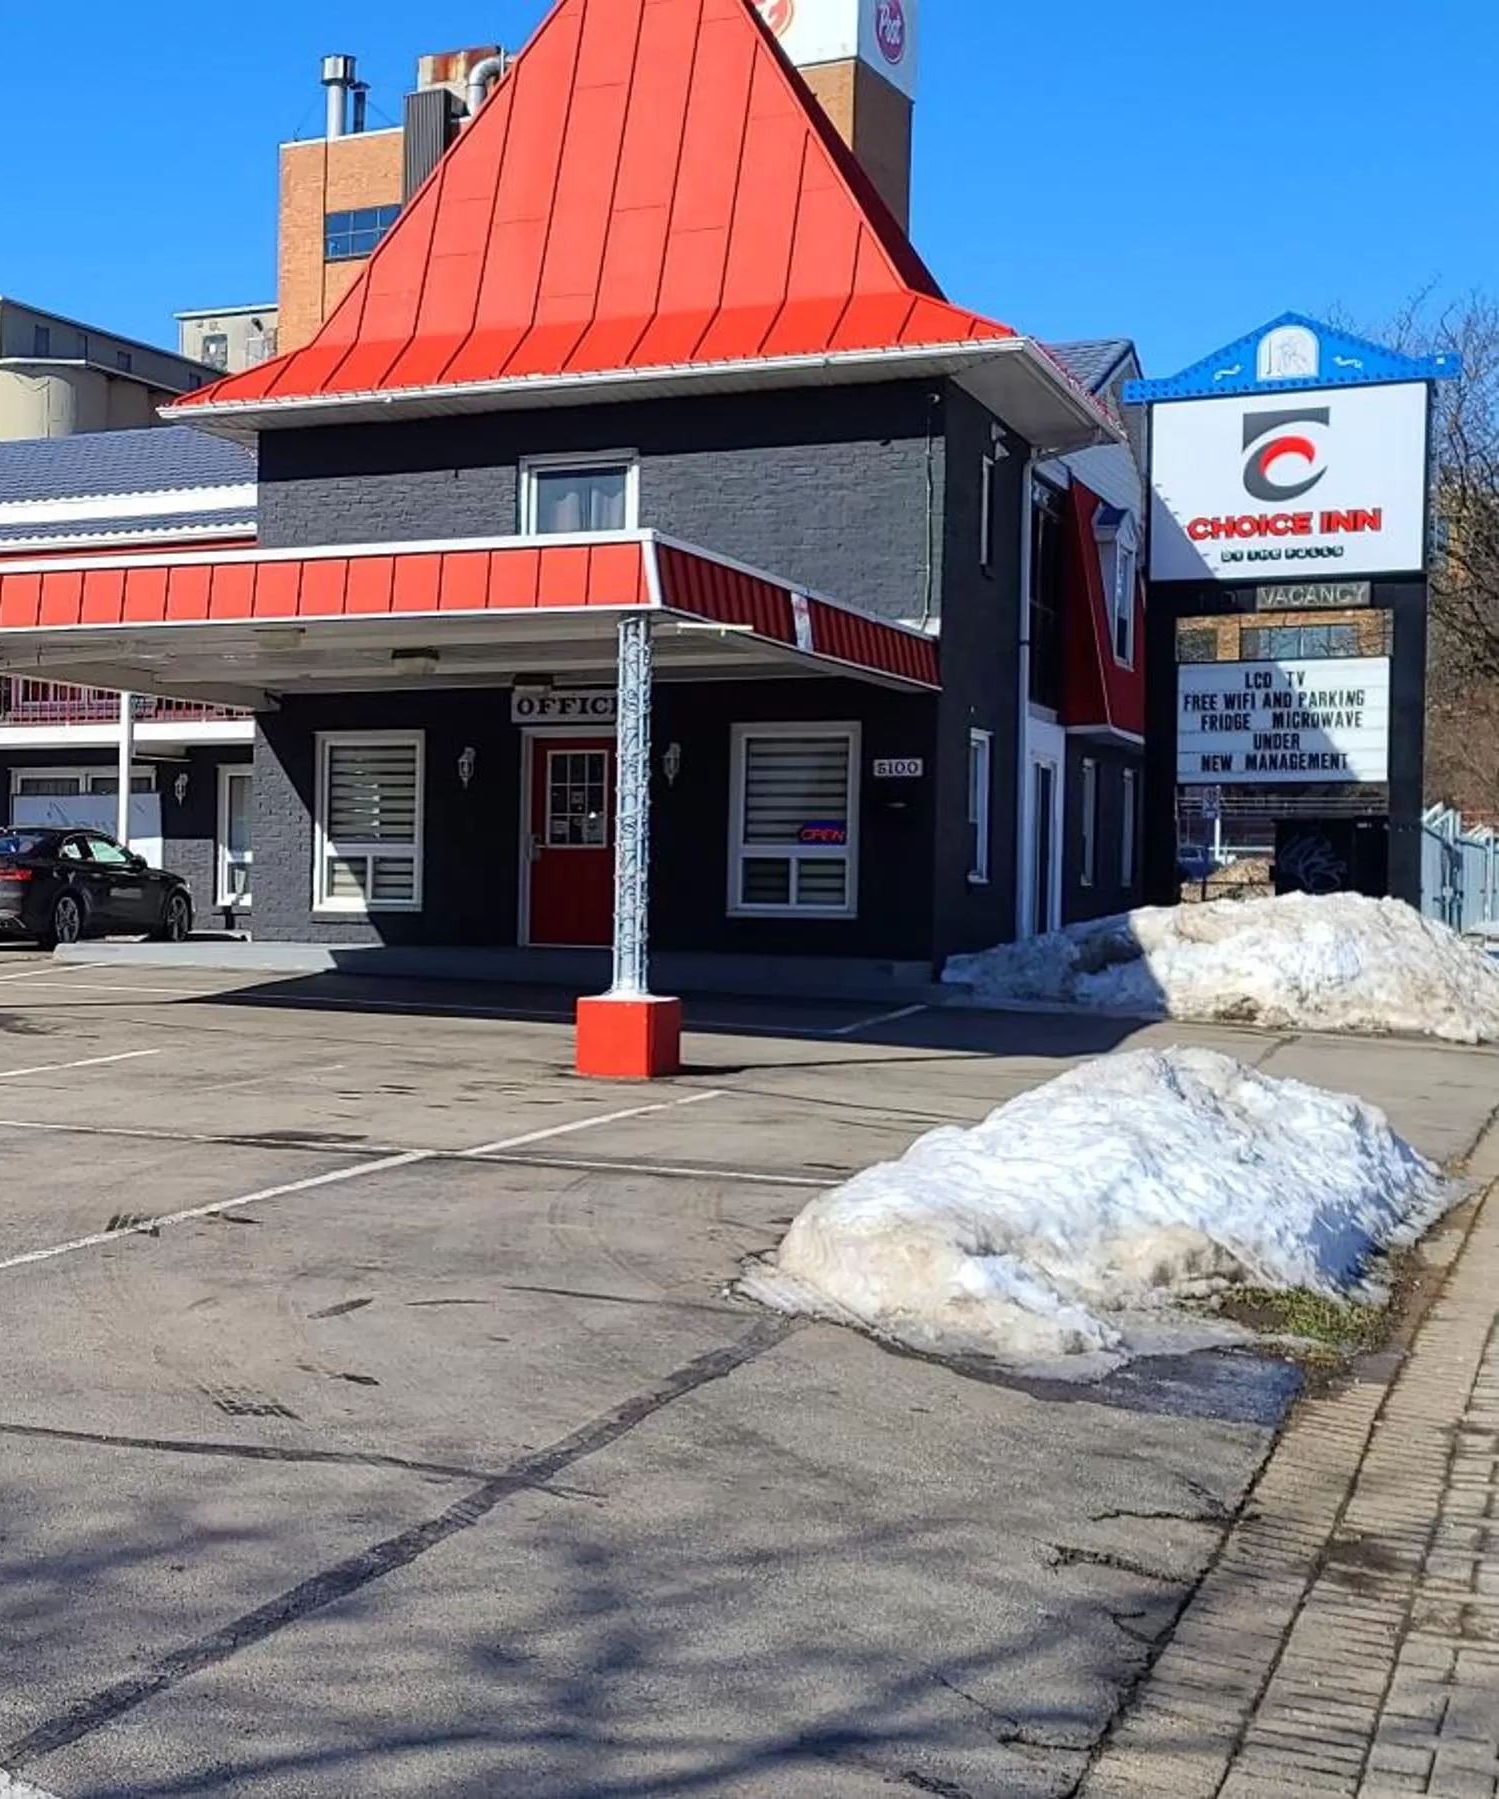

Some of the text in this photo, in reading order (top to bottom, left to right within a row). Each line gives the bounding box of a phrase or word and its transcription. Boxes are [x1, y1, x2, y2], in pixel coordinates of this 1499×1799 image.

[1187, 508, 1382, 541] CHOICE INN
[1258, 583, 1366, 606] VACANCY
[1245, 671, 1306, 690] LCD TV
[516, 696, 618, 717] OFFIC
[1184, 689, 1365, 712] FREE WIFI AND PARKING
[1201, 711, 1363, 732] FRIDGE MICROWAVE
[1253, 733, 1300, 750] UNDER
[877, 761, 919, 775] 5100
[1201, 753, 1348, 773] NEW MANAGEMENT
[801, 828, 845, 841] OPEN
